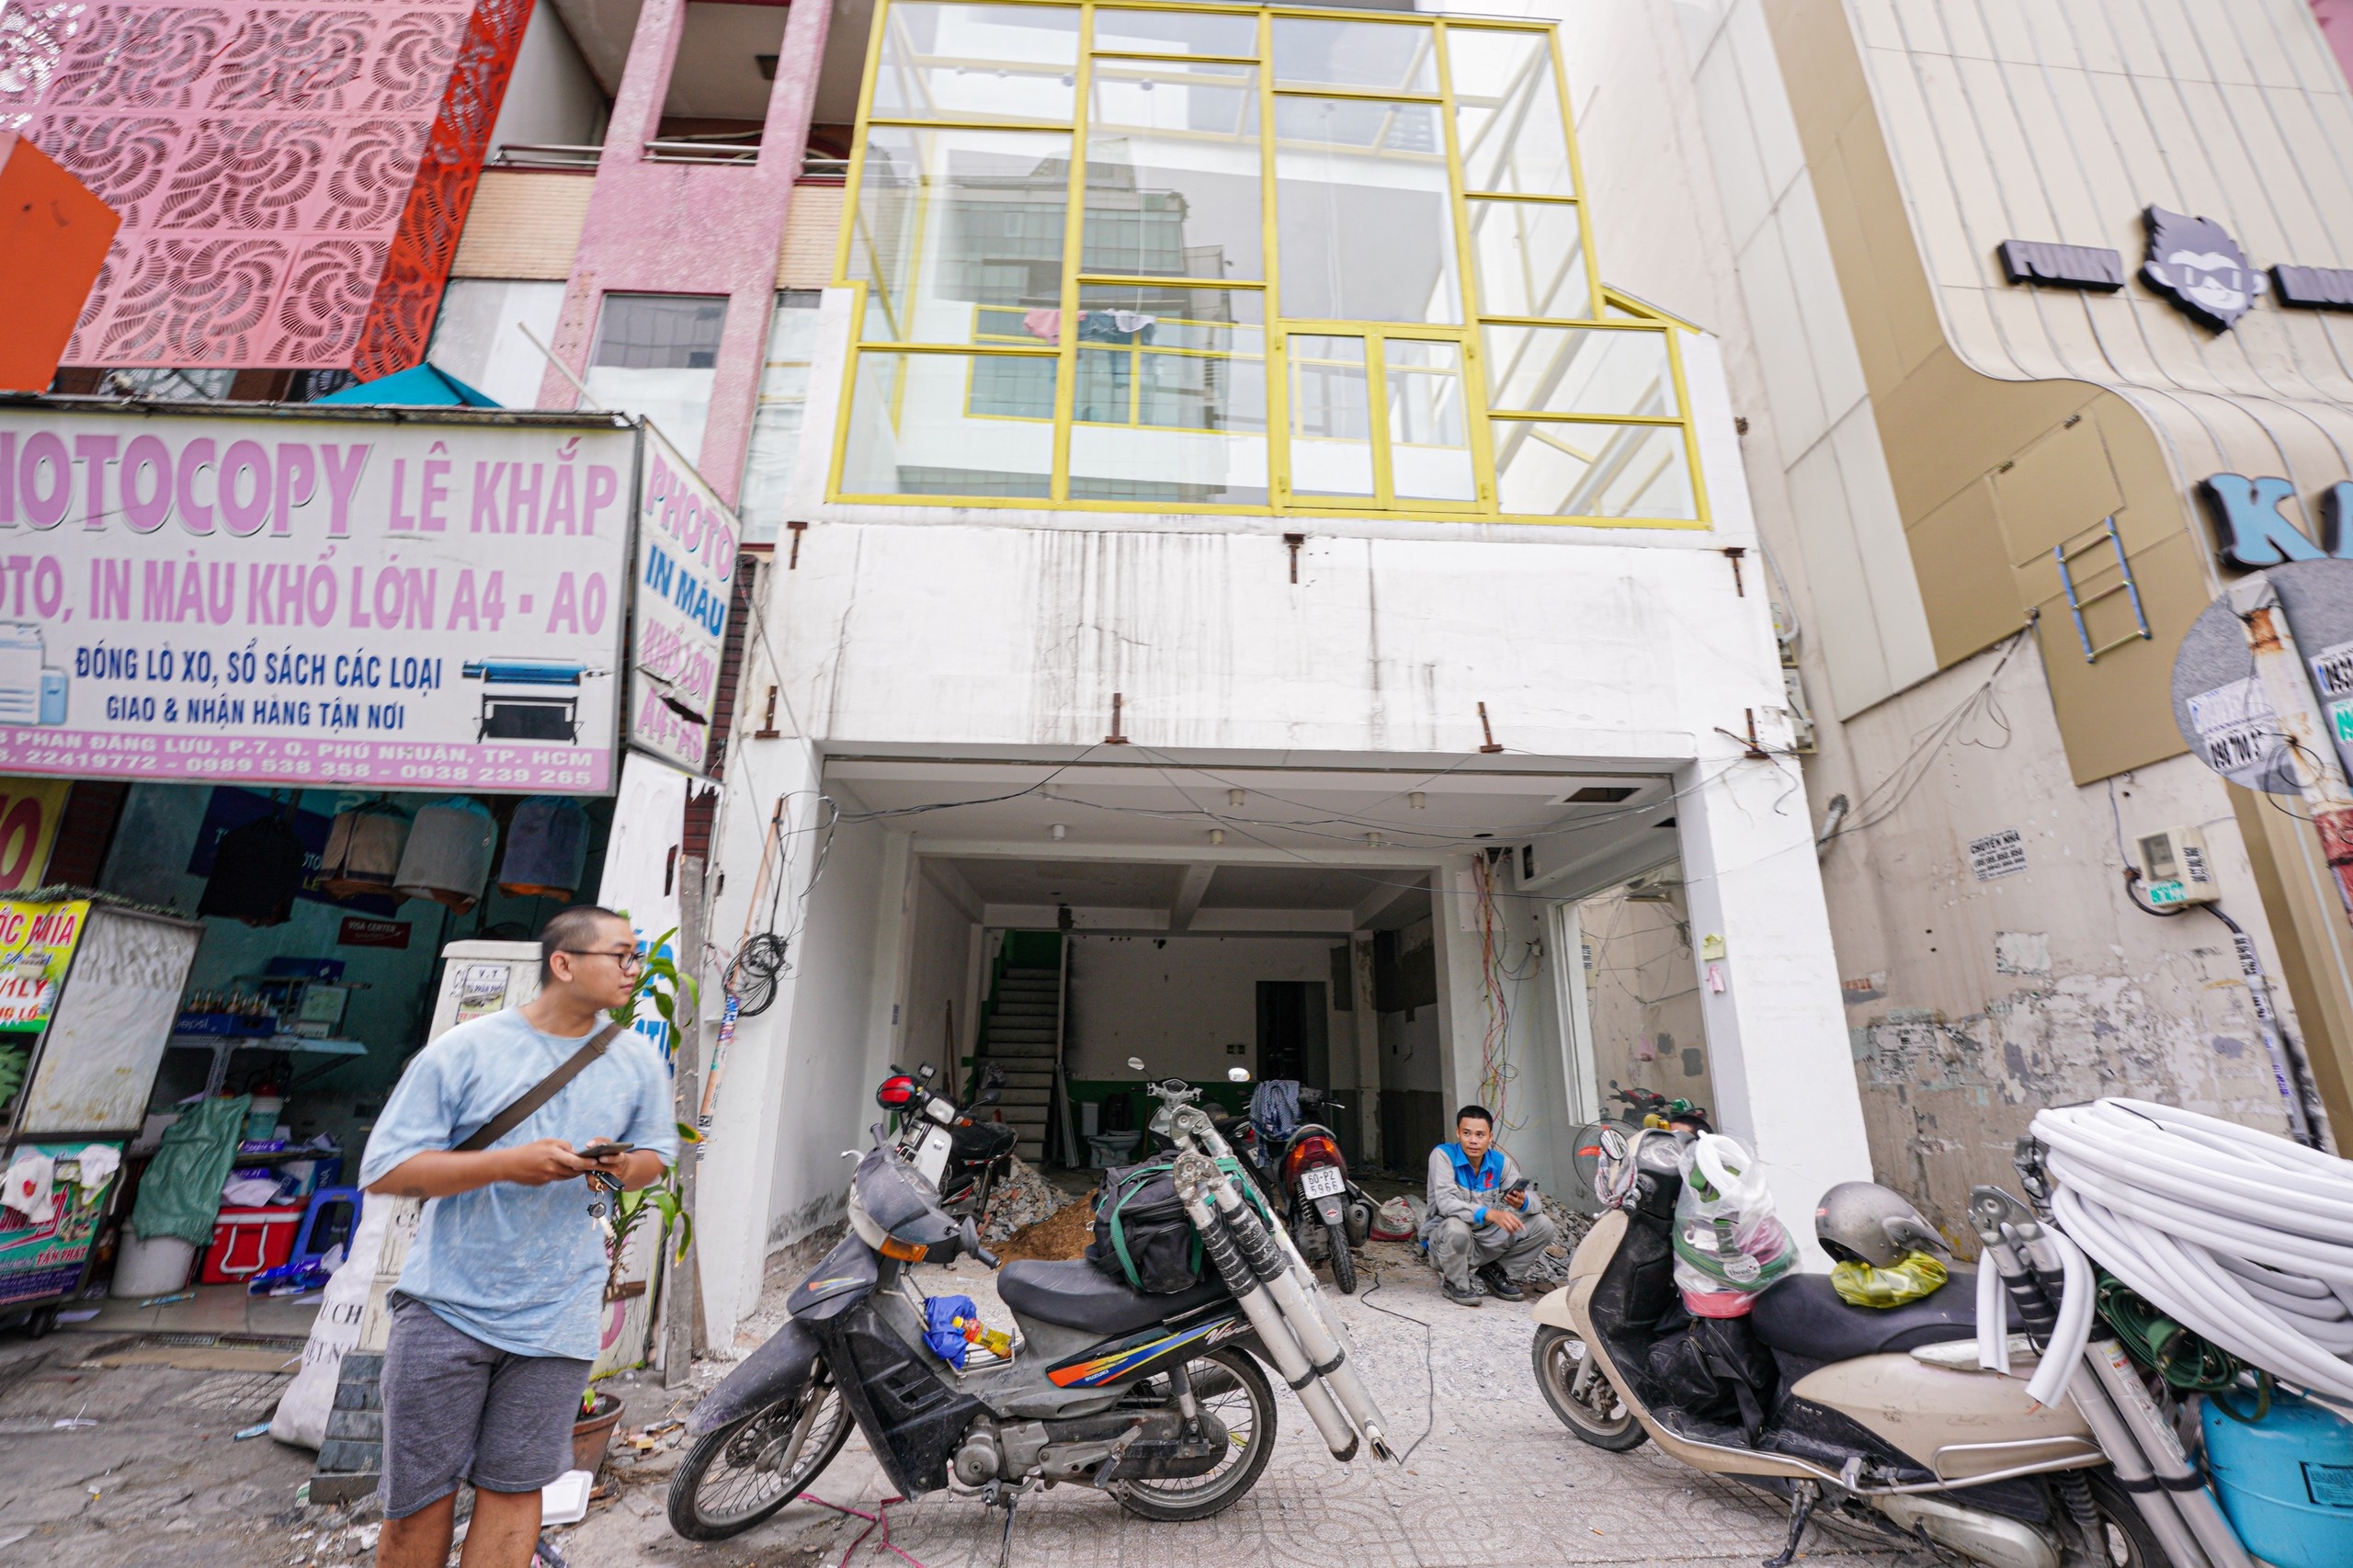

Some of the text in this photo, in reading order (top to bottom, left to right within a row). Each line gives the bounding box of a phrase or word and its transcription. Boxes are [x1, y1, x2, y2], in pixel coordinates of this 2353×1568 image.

[388, 440, 452, 531] LÊ
[469, 437, 618, 536] KHẮP
[643, 454, 735, 582] PHOTO
[0, 554, 74, 623] TO,
[89, 559, 131, 621] IN
[142, 549, 236, 625] MÀU
[246, 544, 337, 629] KHỔ
[348, 553, 438, 631] LỚN
[446, 568, 505, 632] A4
[545, 571, 607, 636] A0
[644, 543, 676, 599] IN
[75, 638, 138, 680] ĐÓNG
[146, 640, 174, 682] LÒ
[182, 650, 218, 688] XO,
[265, 644, 325, 687] SÁCH
[335, 647, 381, 689] CÁC
[390, 657, 443, 698] LOẠI
[107, 693, 405, 734] GIAO & NHẬN HÀNG TẬN NƠI
[15, 731, 83, 749] PHAN
[229, 740, 278, 757] P.7,
[318, 740, 370, 759] PHÚ
[379, 744, 474, 765] NHUẬN,
[483, 749, 524, 765] TP.
[531, 751, 593, 767] HCM
[25, 749, 158, 771] 22419772
[186, 756, 253, 774] 0989
[260, 760, 312, 775] 538
[319, 761, 370, 779] 358
[400, 766, 470, 782] 0938
[478, 767, 531, 784] 239
[539, 769, 593, 787] 265
[1308, 1171, 1336, 1185] 60-P2
[1085, 1369, 1109, 1382] SUZUKI
